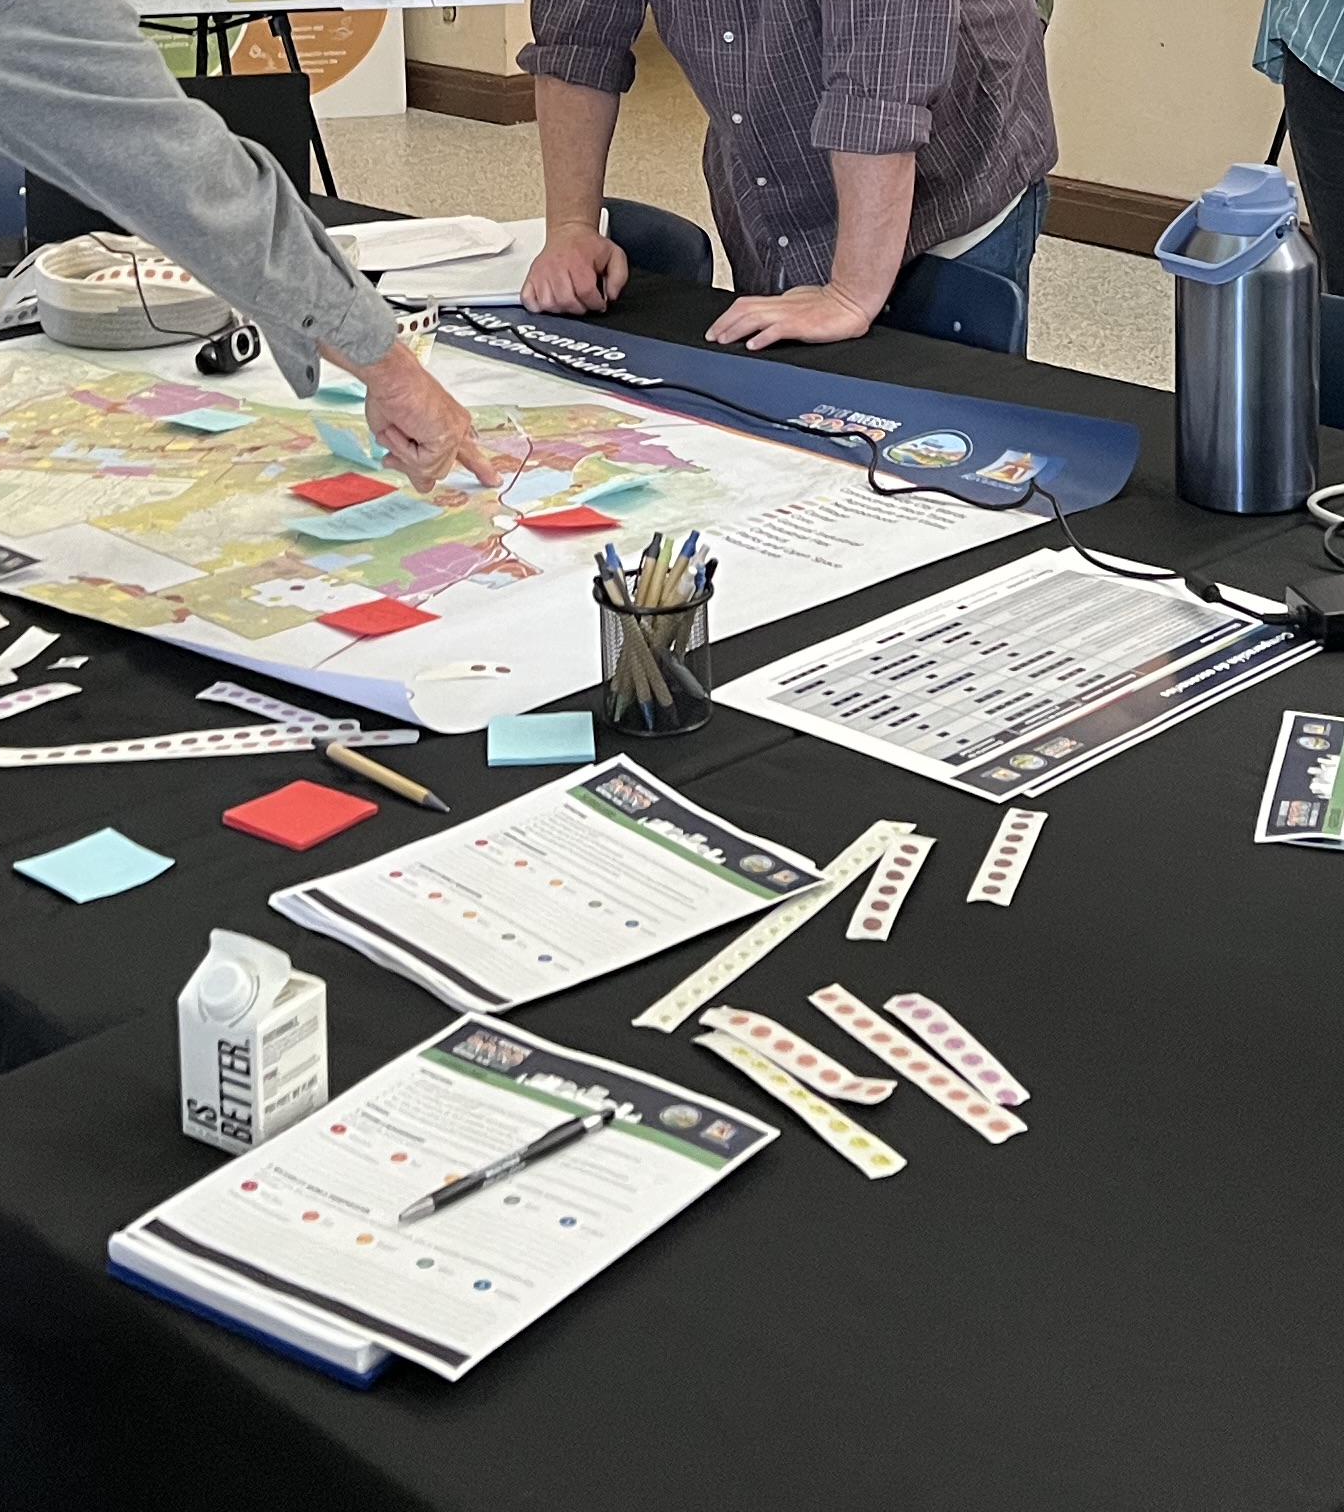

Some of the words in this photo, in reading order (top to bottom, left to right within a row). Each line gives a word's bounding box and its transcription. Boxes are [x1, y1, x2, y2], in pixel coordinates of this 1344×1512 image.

[438, 324, 476, 337] de
[517, 324, 625, 361] scenario
[187, 1098, 217, 1131] IS
